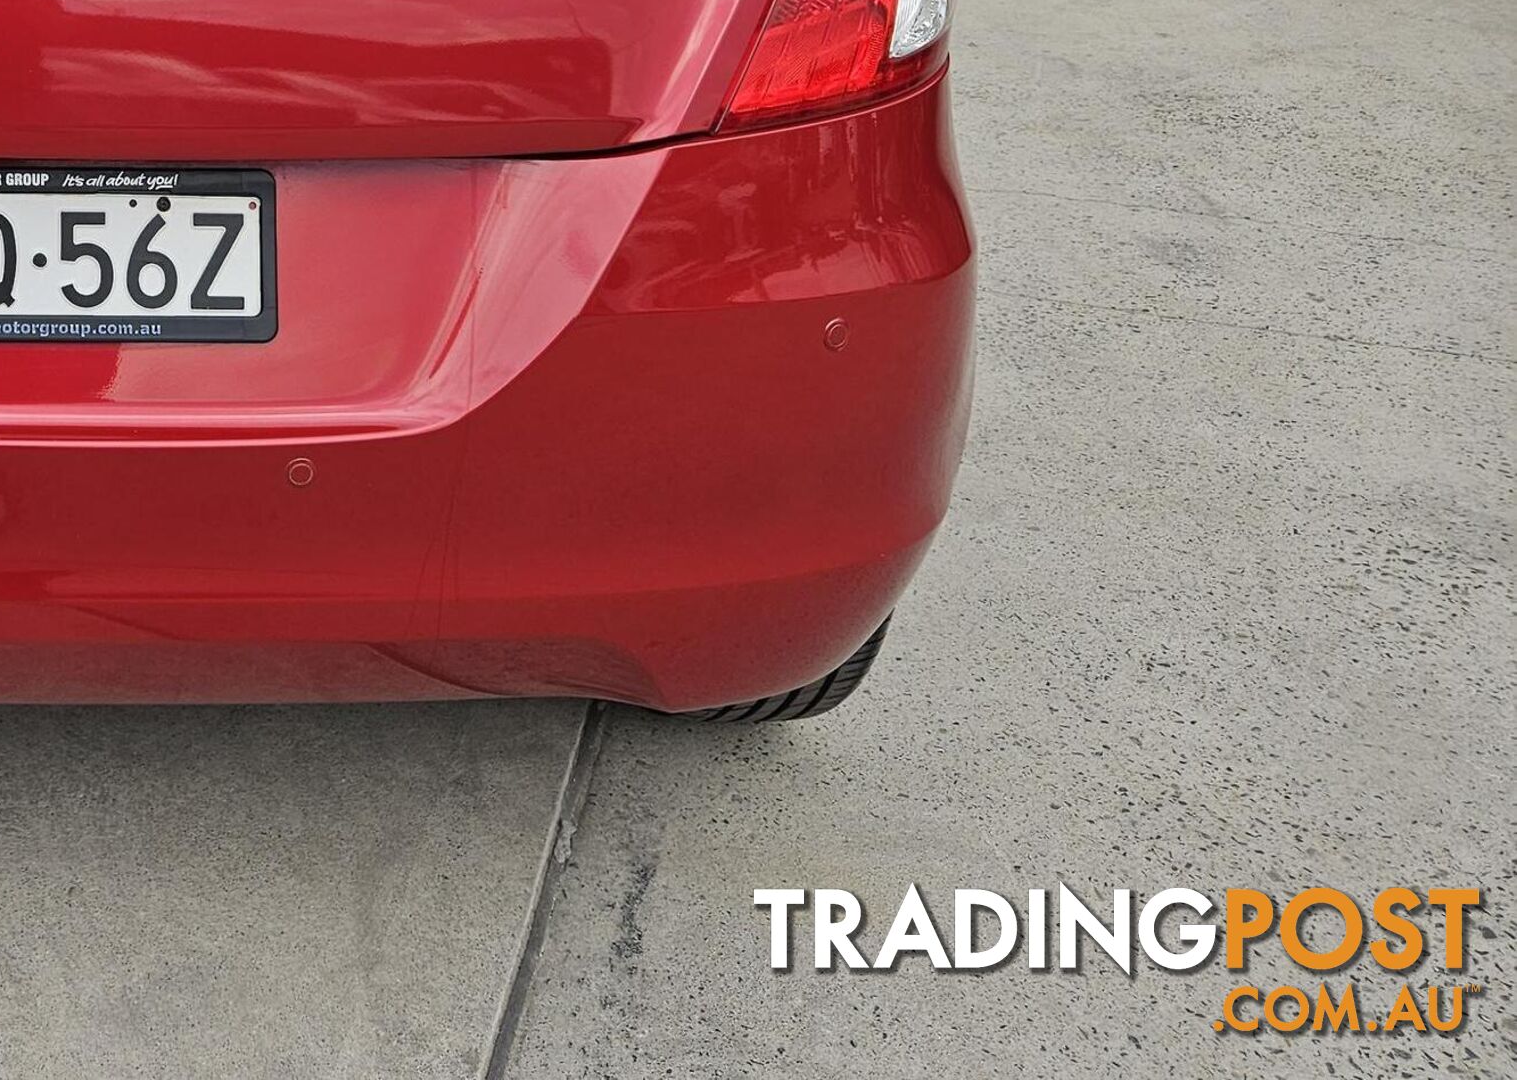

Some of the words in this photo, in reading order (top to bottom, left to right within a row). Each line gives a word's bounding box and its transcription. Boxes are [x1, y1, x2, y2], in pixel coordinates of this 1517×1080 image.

[5, 172, 50, 186] GROUP
[62, 173, 85, 187] It's
[85, 174, 106, 187] all
[105, 171, 146, 186] about
[146, 173, 179, 190] you!
